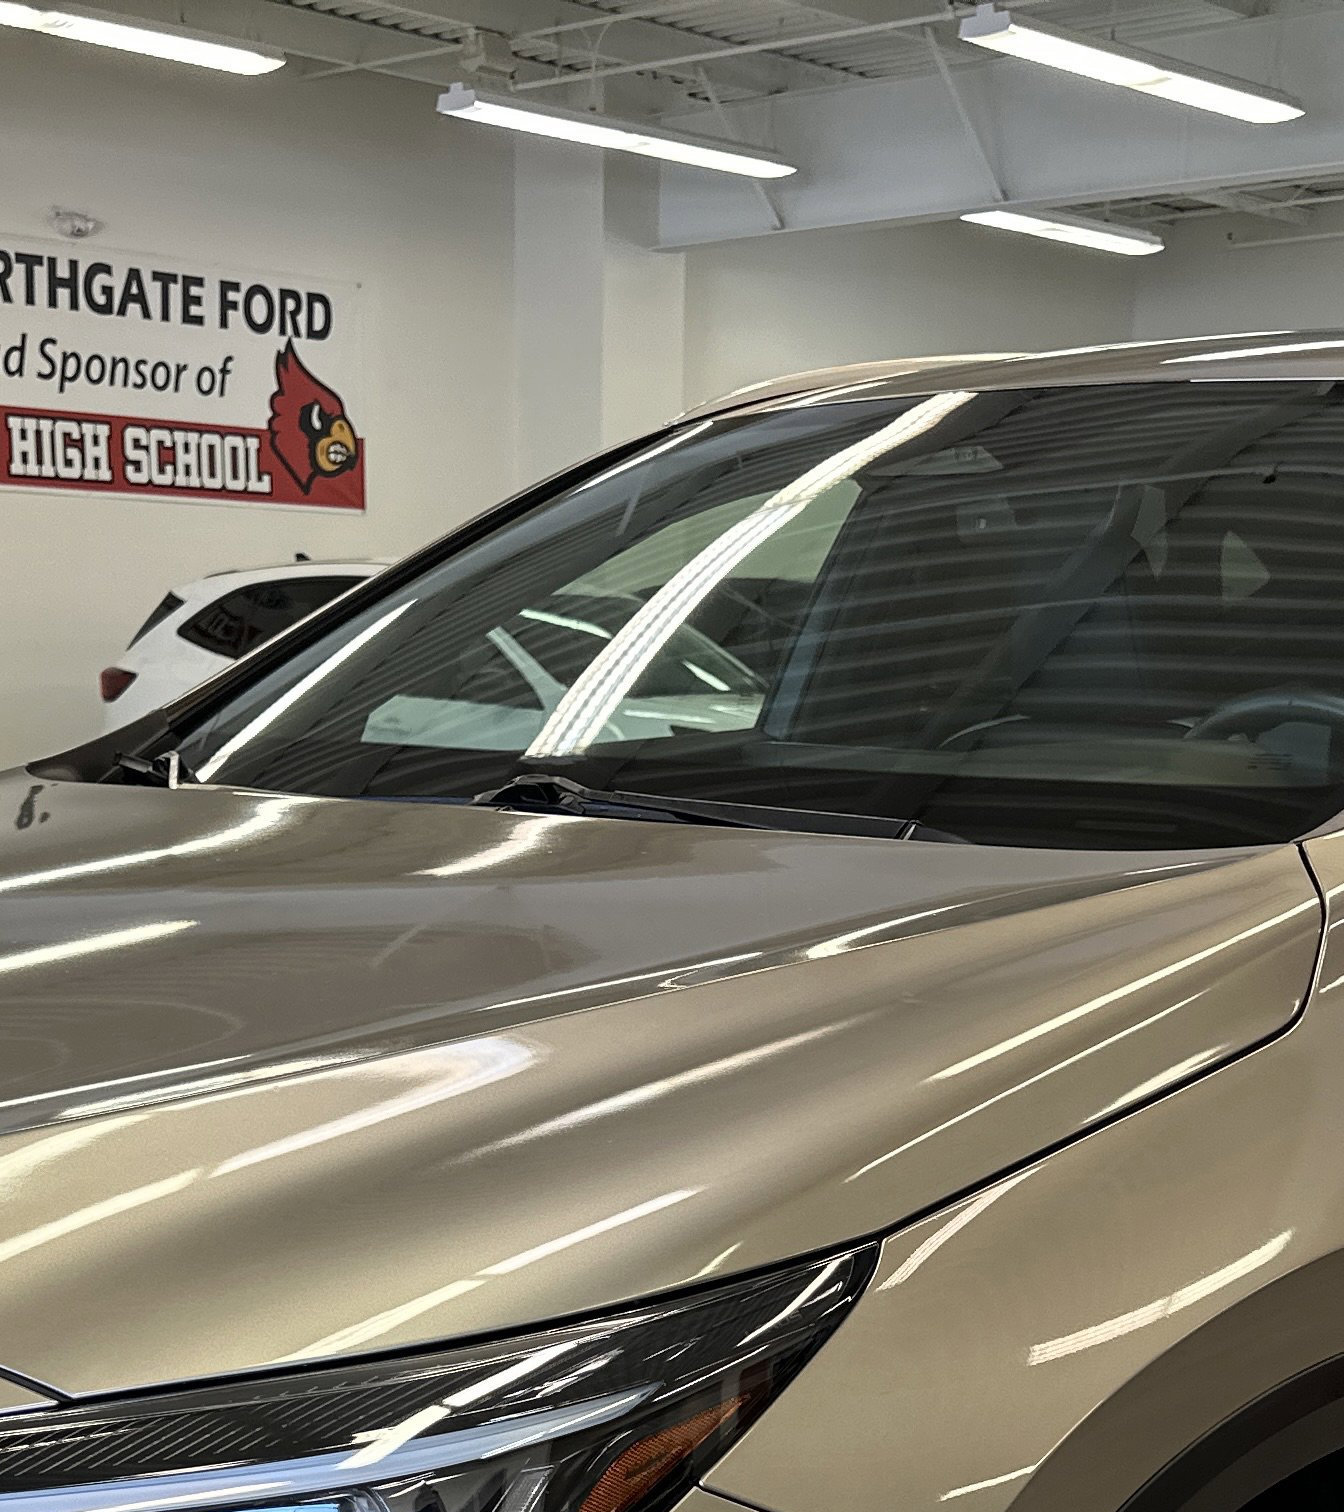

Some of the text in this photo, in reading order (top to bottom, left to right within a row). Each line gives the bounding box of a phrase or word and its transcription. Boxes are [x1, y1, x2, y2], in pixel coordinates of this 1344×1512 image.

[219, 281, 333, 341] FORD
[38, 337, 188, 395] Sponsor
[197, 356, 235, 397] of
[7, 415, 113, 484] HIGH
[122, 428, 273, 495] SCHOOL
